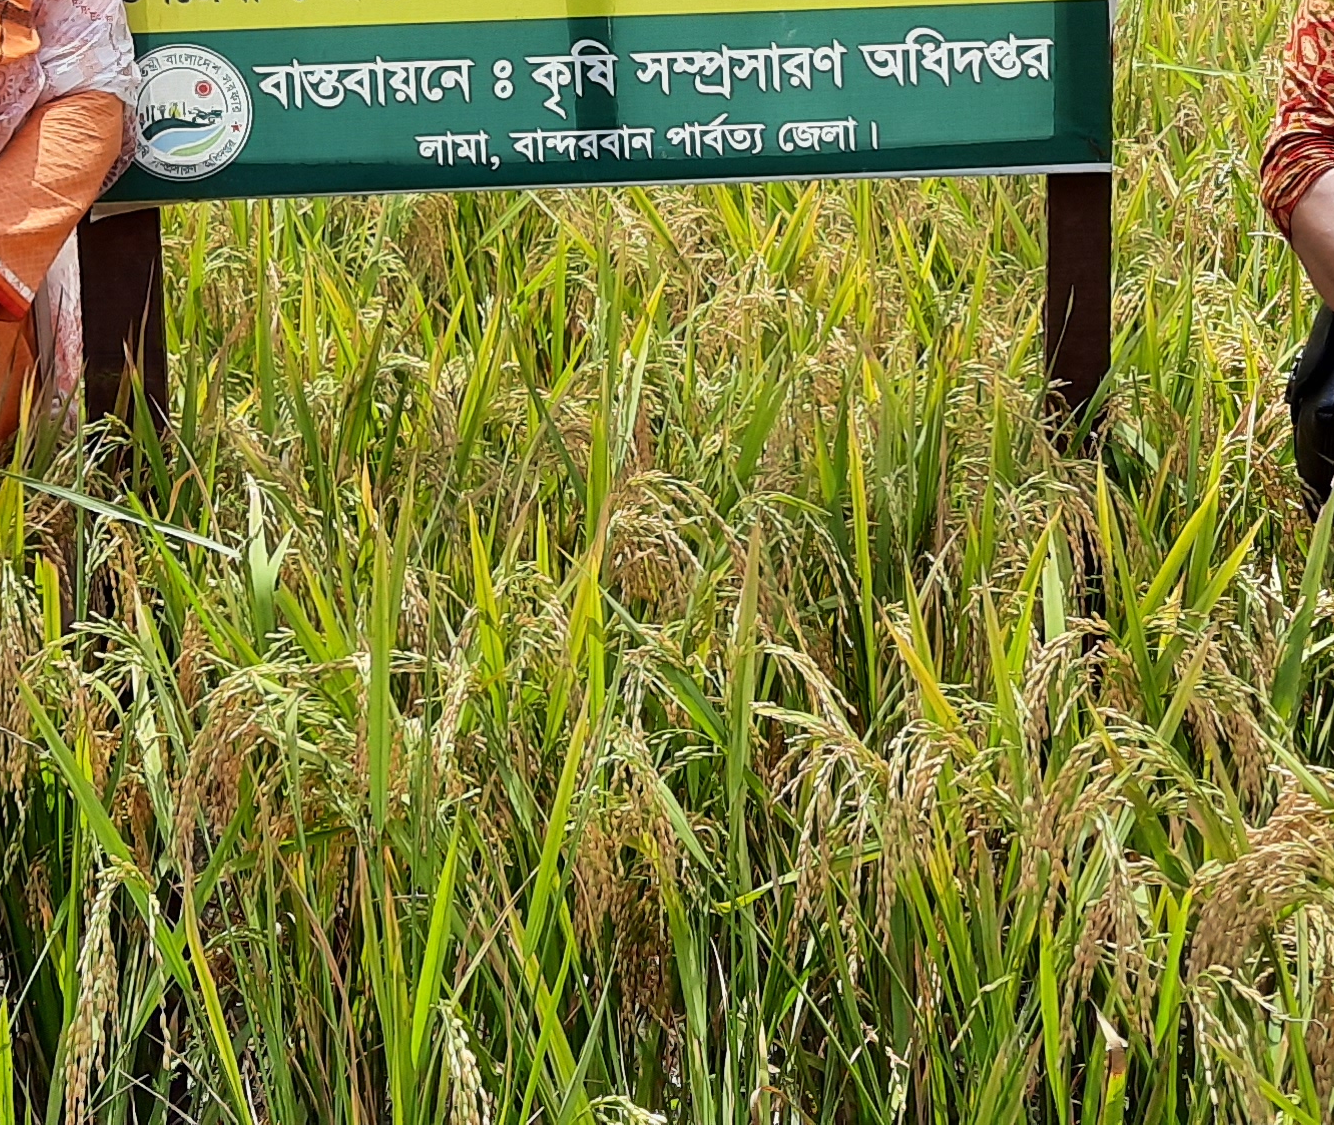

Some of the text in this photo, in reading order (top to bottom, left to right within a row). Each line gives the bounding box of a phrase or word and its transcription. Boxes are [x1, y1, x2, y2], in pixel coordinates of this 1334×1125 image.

[164, 54, 221, 74] বাংলাদেশ
[253, 56, 475, 109] বাস্তবায়নে
[525, 40, 618, 119] কৃষি
[630, 40, 847, 99] সম্প্রসারণ
[858, 28, 1054, 86] অধিদপ্তর
[415, 130, 499, 169] লামা,
[509, 125, 655, 162] বান্দরবান
[667, 113, 765, 157] পার্বত্য
